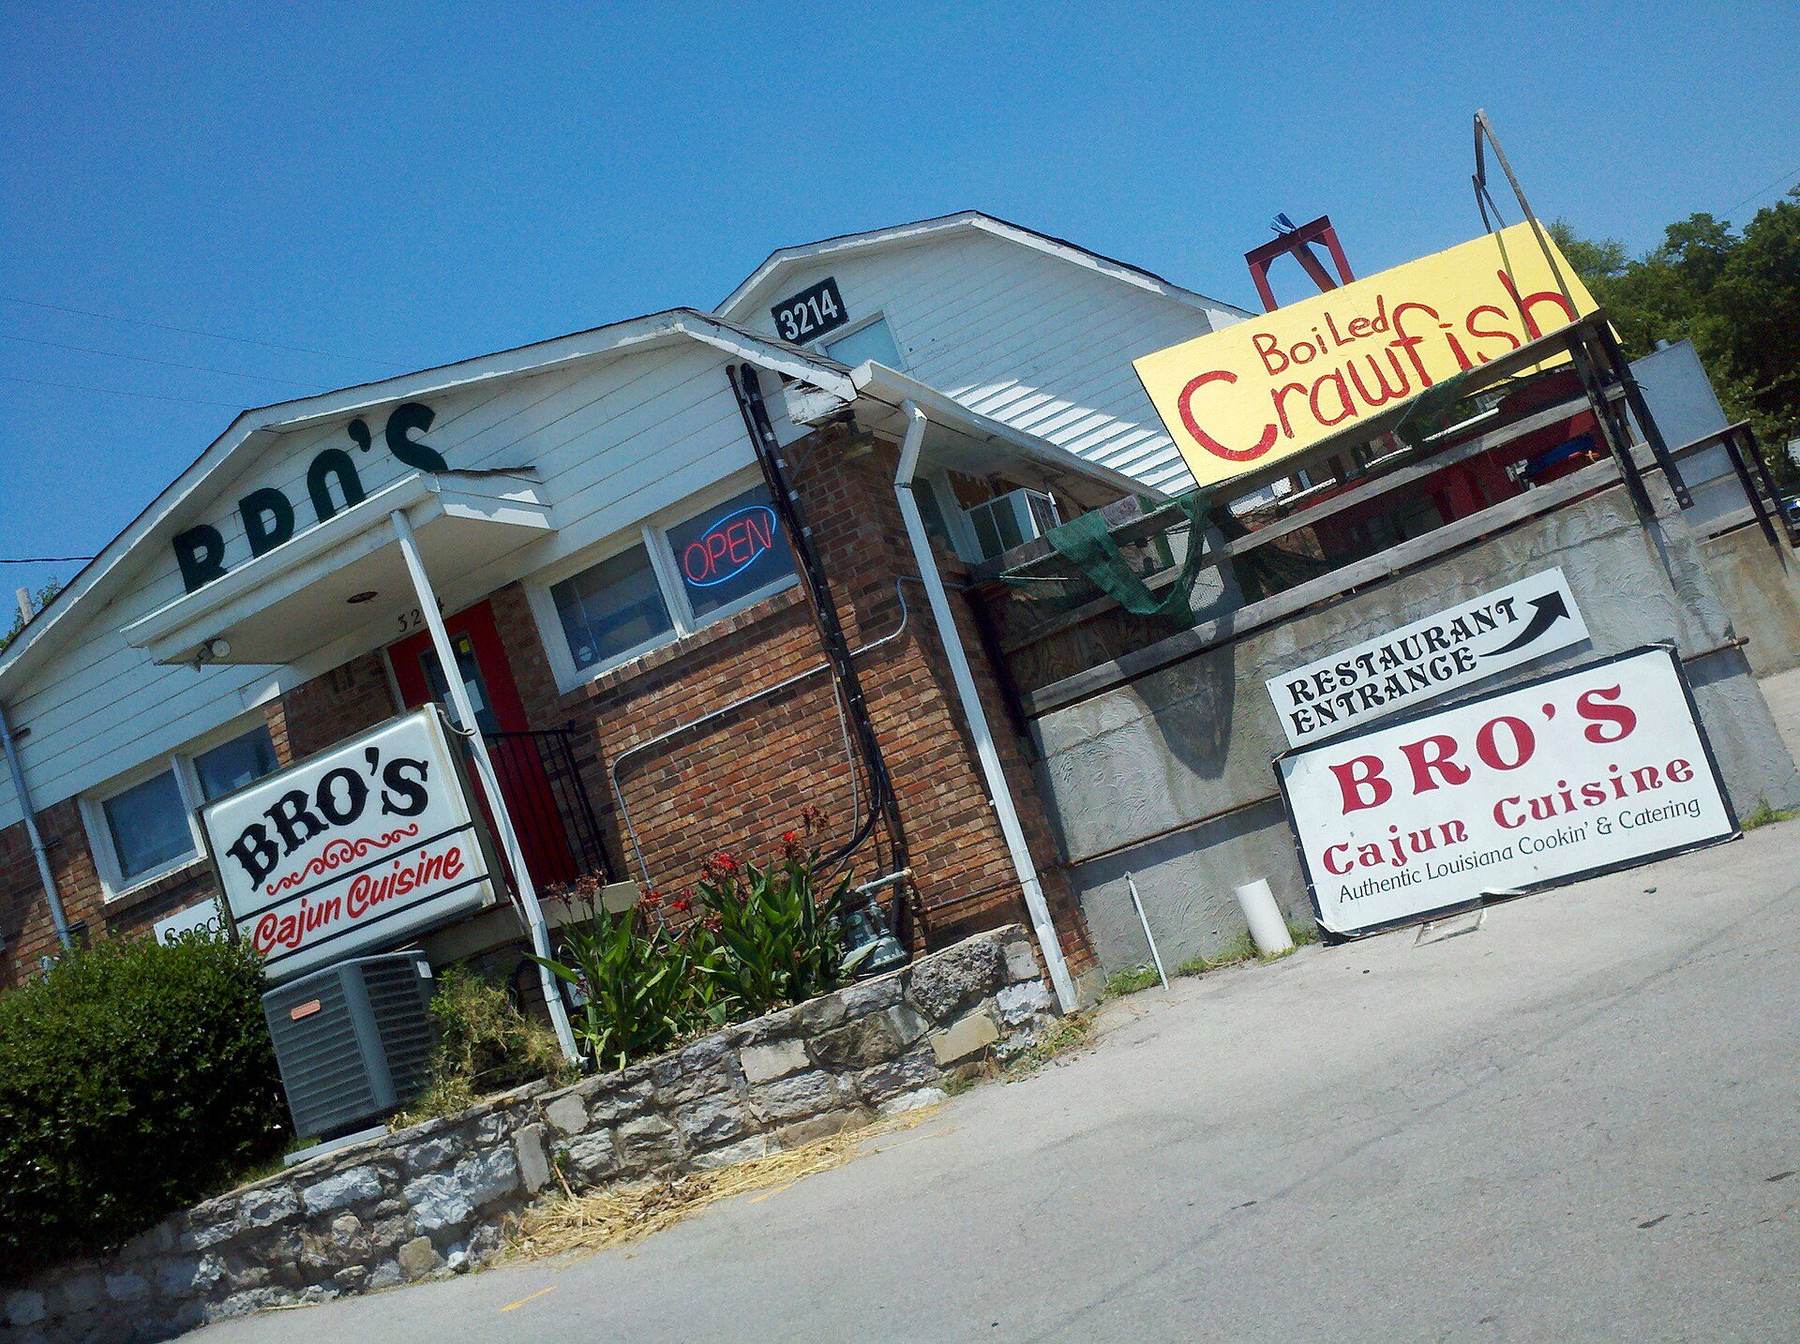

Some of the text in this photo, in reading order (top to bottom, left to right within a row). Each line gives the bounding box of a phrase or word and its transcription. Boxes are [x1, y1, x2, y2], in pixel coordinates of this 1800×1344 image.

[780, 289, 838, 340] 3214
[1178, 269, 1580, 461] Crawfish
[684, 512, 772, 581] OPEN
[1286, 596, 1520, 706] RESTAURANT
[1289, 646, 1477, 737] ENTRANCE
[1329, 683, 1637, 816] BRO'S
[226, 747, 429, 892] BRO'S
[1323, 758, 1694, 876] Cajun Cuisine
[1339, 798, 1701, 904] Authentic Louisiana Cookin' & Catering
[253, 847, 464, 957] Cajun Cuisine
